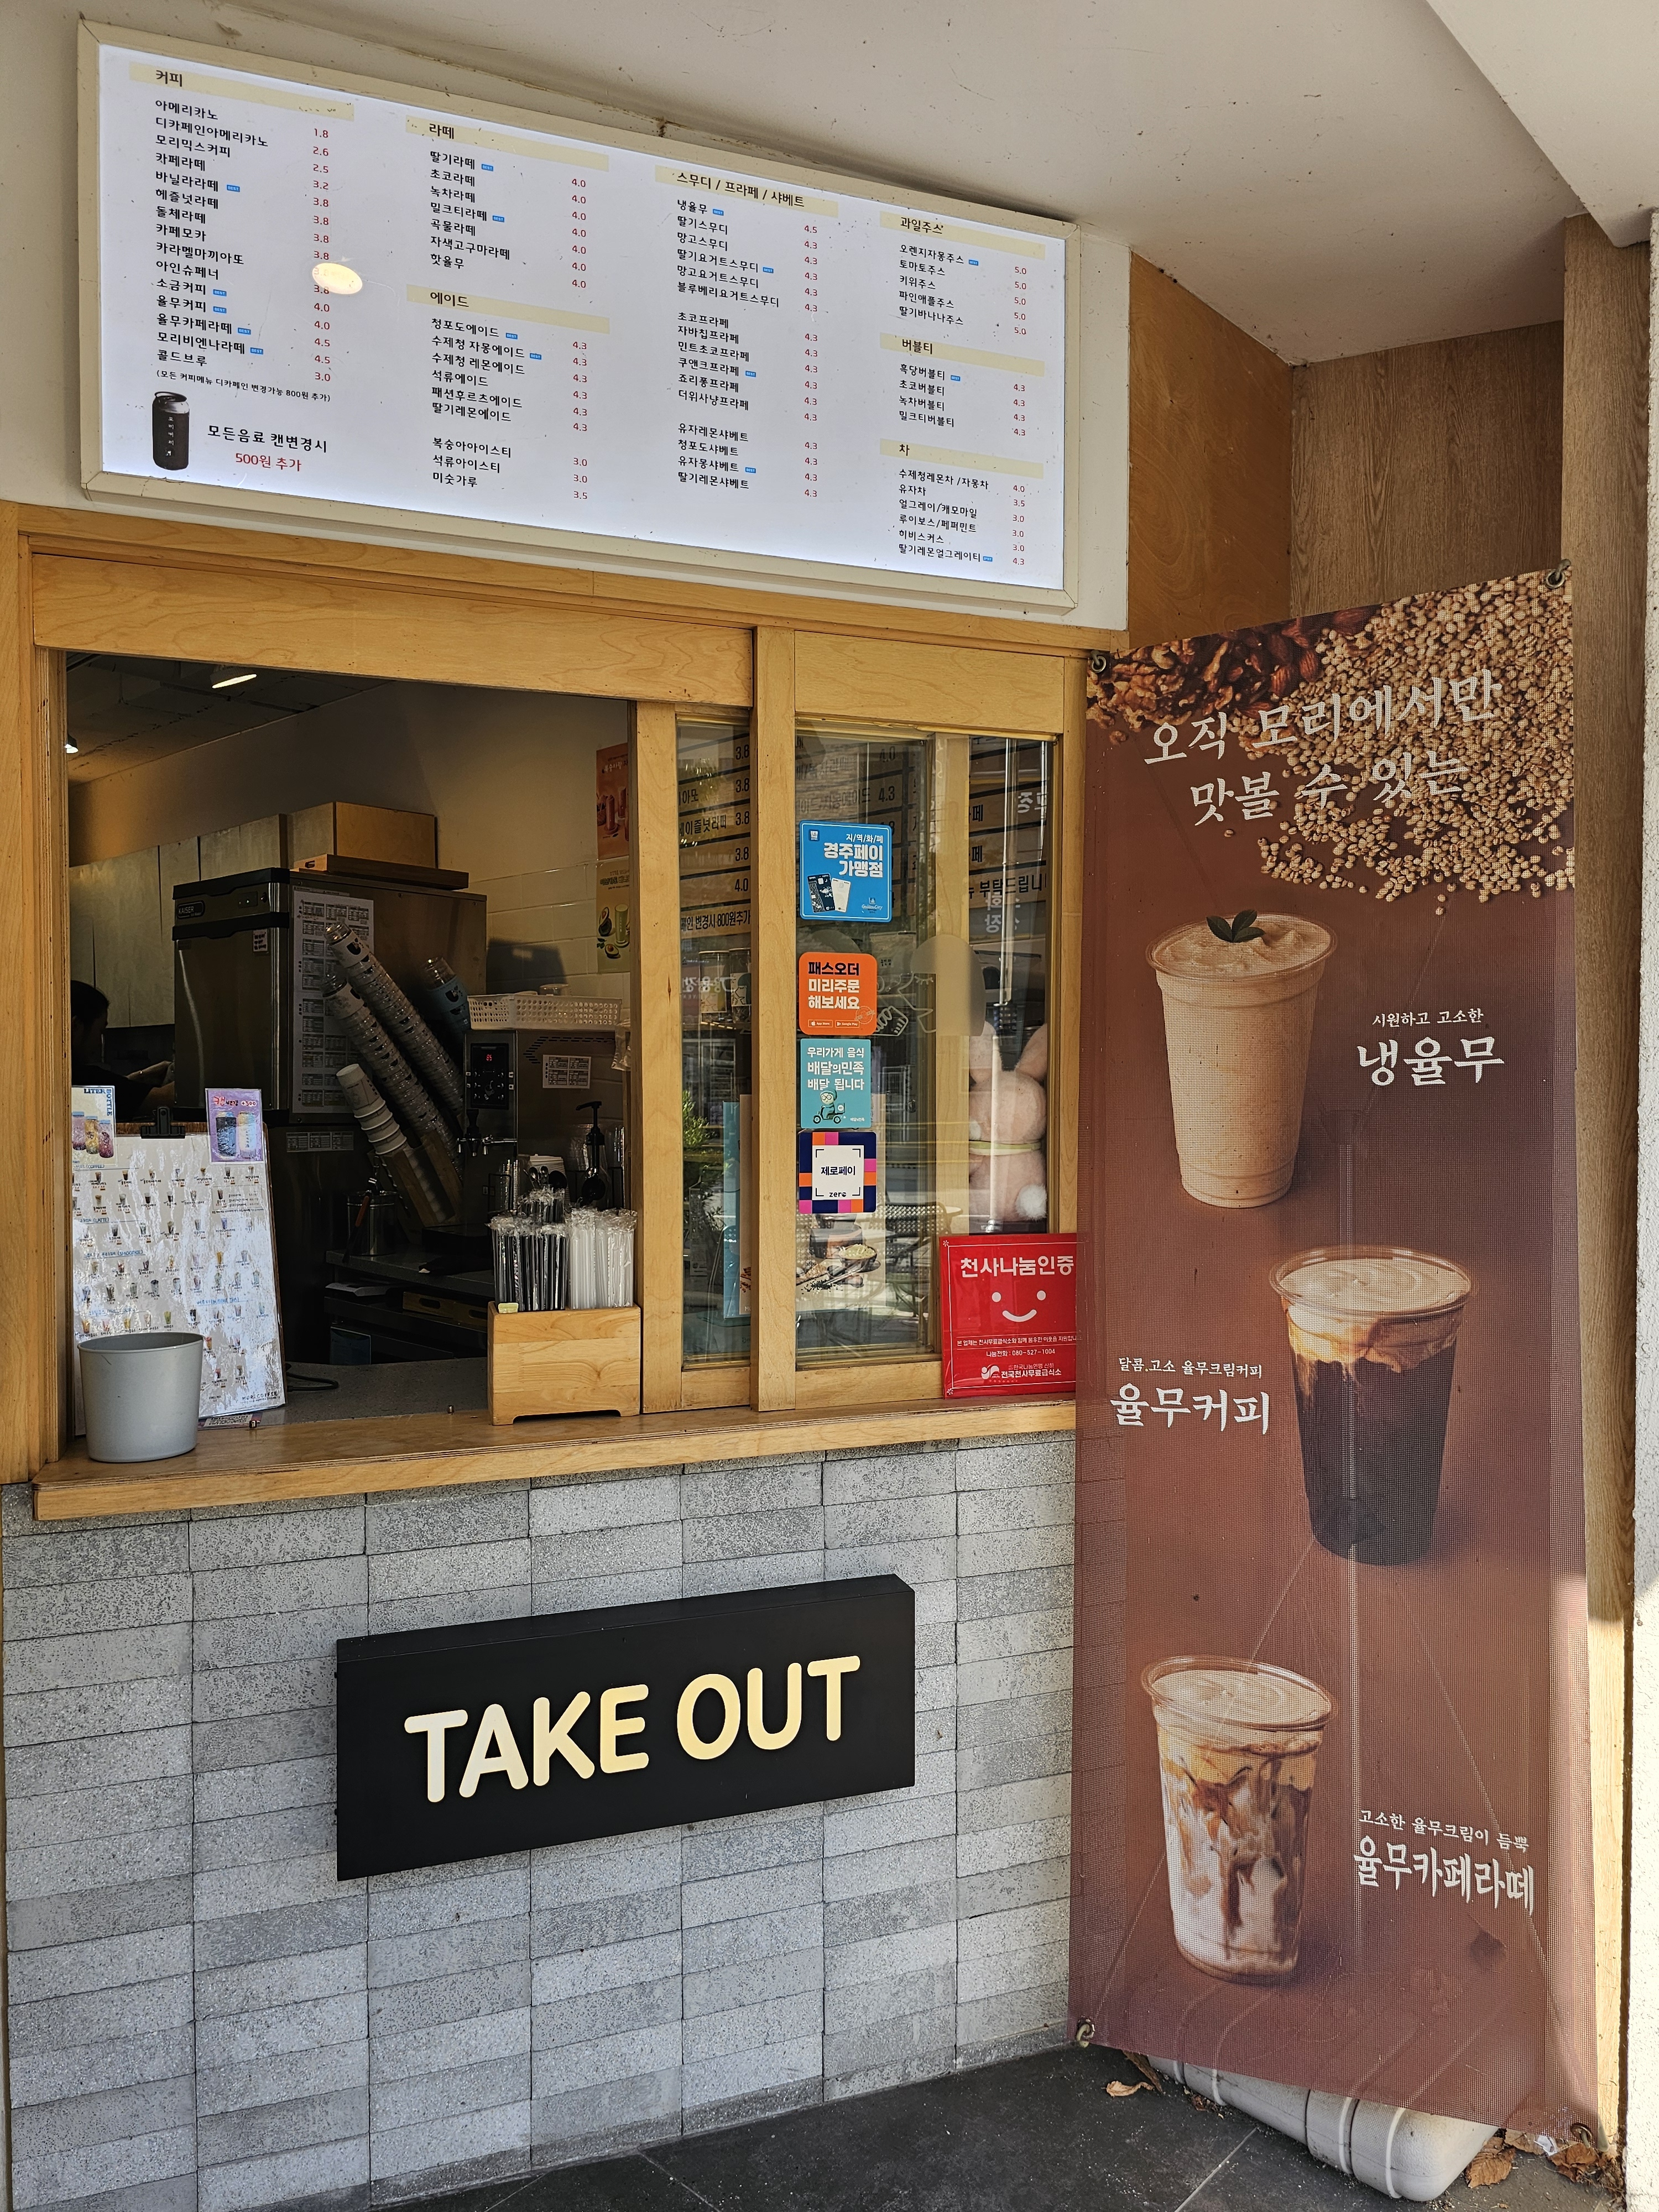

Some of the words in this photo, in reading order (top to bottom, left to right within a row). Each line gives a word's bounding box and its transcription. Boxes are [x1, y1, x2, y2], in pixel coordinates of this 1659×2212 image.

[155, 70, 182, 87] 커피
[155, 100, 218, 120] 아메리카노
[156, 117, 268, 147] 디카페인아메리카노
[314, 128, 328, 138] 1.8
[429, 123, 455, 139] 라떼
[155, 134, 230, 158] 모리믹스커피
[313, 146, 328, 156] 2.6
[156, 153, 205, 171] 카페라떼
[313, 164, 328, 173] 2.5
[430, 150, 475, 170] 딸기라떼
[156, 171, 218, 192] 바닐라라떼
[313, 180, 328, 190] 3.2
[430, 169, 474, 187] 초코라떼
[571, 179, 586, 187] 4.0
[677, 173, 711, 190] 스무디
[716, 180, 721, 190] /
[724, 181, 758, 200] 프라페
[762, 189, 768, 200] /
[771, 191, 805, 207] 샤베트
[430, 202, 487, 222] 밀크티라떼
[677, 199, 708, 215] 냉율무
[156, 223, 206, 242] 카페모카
[677, 216, 728, 236] 딸기스무디
[804, 225, 817, 233] 4.5
[900, 217, 943, 234] 과일주스
[156, 242, 244, 265] 카라멜마끼아또
[431, 236, 510, 260] 자색고구마라떼
[899, 244, 964, 264] 오렌지자몽주스
[430, 253, 465, 269] 핫율무
[677, 248, 758, 273] 딸기요거트스무디
[899, 259, 945, 276] 토마토주스
[156, 260, 218, 280] 아인슈페너
[1015, 266, 1027, 275] 5.0
[156, 278, 206, 295] 소금커피
[677, 281, 779, 308] 블루베리요거트스무디
[156, 295, 206, 313] 율무커피
[430, 292, 469, 307] 에이드
[899, 290, 954, 309] 파인애플주스
[156, 313, 232, 335] 율무카페라떼
[677, 312, 729, 329] 초코프라페
[899, 306, 963, 325] 딸기바나나주스
[431, 318, 499, 337] 청포도에이드
[156, 332, 245, 354] 모리비엔나라떼
[431, 335, 465, 351] 수제청
[469, 341, 525, 358] 자몽에이드
[572, 341, 587, 349] 4.3
[678, 341, 749, 362] 민트초코프라페
[902, 339, 932, 355] 버블티
[157, 349, 207, 367] 콜드브루
[678, 357, 739, 377] 쿠앤크프라페
[315, 372, 331, 382] 3.0
[899, 363, 945, 381] 흑당버블티
[180, 373, 213, 385] 커피메뉴
[216, 378, 248, 391] 디카페인
[251, 384, 283, 396] 변경가능
[286, 389, 309, 400] 800원
[311, 393, 330, 402] 추가)
[431, 387, 523, 408] 패션후르츠에이드
[679, 389, 748, 411] 더위사냥프라페
[899, 410, 954, 428] 밀크티버블티
[207, 425, 265, 444] 모든음료
[270, 434, 326, 453] 캔변경시
[677, 423, 748, 442] 유자레몬샤베트
[432, 437, 511, 458] 복숭아아이스티
[899, 444, 910, 457] 차
[236, 453, 271, 469] 500원
[275, 457, 302, 472] 추가
[433, 472, 477, 488] 미숫가루
[677, 472, 749, 489] 딸기레몬샤베트
[899, 468, 954, 486] 수제청레몬차
[957, 477, 989, 490] /자몽차
[573, 491, 587, 499] 3.5
[899, 484, 926, 497] 유자차
[899, 499, 977, 519] 얼그레이/캐모마일
[1014, 499, 1025, 507] 3.5
[899, 514, 977, 533] 루이보스/페퍼민트
[899, 544, 980, 562] 딸기레몬얼그레이티
[1144, 711, 1228, 765] 오직
[1251, 668, 1502, 750] 모리에서만
[735, 744, 749, 760] 3.8
[735, 778, 750, 793] 3.8
[878, 786, 895, 802] 4.3
[1190, 770, 1280, 827] 맛볼
[1301, 763, 1348, 809] 수
[1371, 750, 1469, 806] 있는
[735, 811, 750, 826] 3.8
[735, 847, 749, 861] 3.8
[824, 842, 883, 861] 경주페이
[839, 860, 883, 878] 가맹점
[734, 878, 749, 892] 4.0
[696, 914, 716, 930] 변경시
[808, 962, 859, 975] 패스오더
[808, 978, 860, 993] 미리주문
[808, 995, 860, 1010] 해보세요
[1372, 1012, 1431, 1028] 시원하고
[1437, 1008, 1484, 1024] 고소한
[807, 1047, 843, 1058] 우리가게
[847, 1047, 864, 1058] 음식
[1357, 1036, 1505, 1086] 냉율무
[807, 1061, 864, 1075] 배달의민족
[807, 1078, 830, 1090] 배달
[834, 1078, 864, 1091] 됩니다
[821, 1166, 855, 1175] 제로페이
[961, 1255, 1074, 1278] 천사나눔인증
[1001, 1368, 1062, 1379] 전국천사무료급식소
[1182, 1360, 1262, 1379] 율무크림커피
[1110, 1383, 1270, 1435] 율무커피
[404, 1684, 650, 1803] TAKE
[677, 1655, 861, 1760] OUT
[1359, 1810, 1405, 1830] 고소한
[1411, 1817, 1489, 1845] 율무크림이
[1496, 1832, 1530, 1853] 듬뿍
[1353, 1835, 1533, 1916] 율무카페라떼
